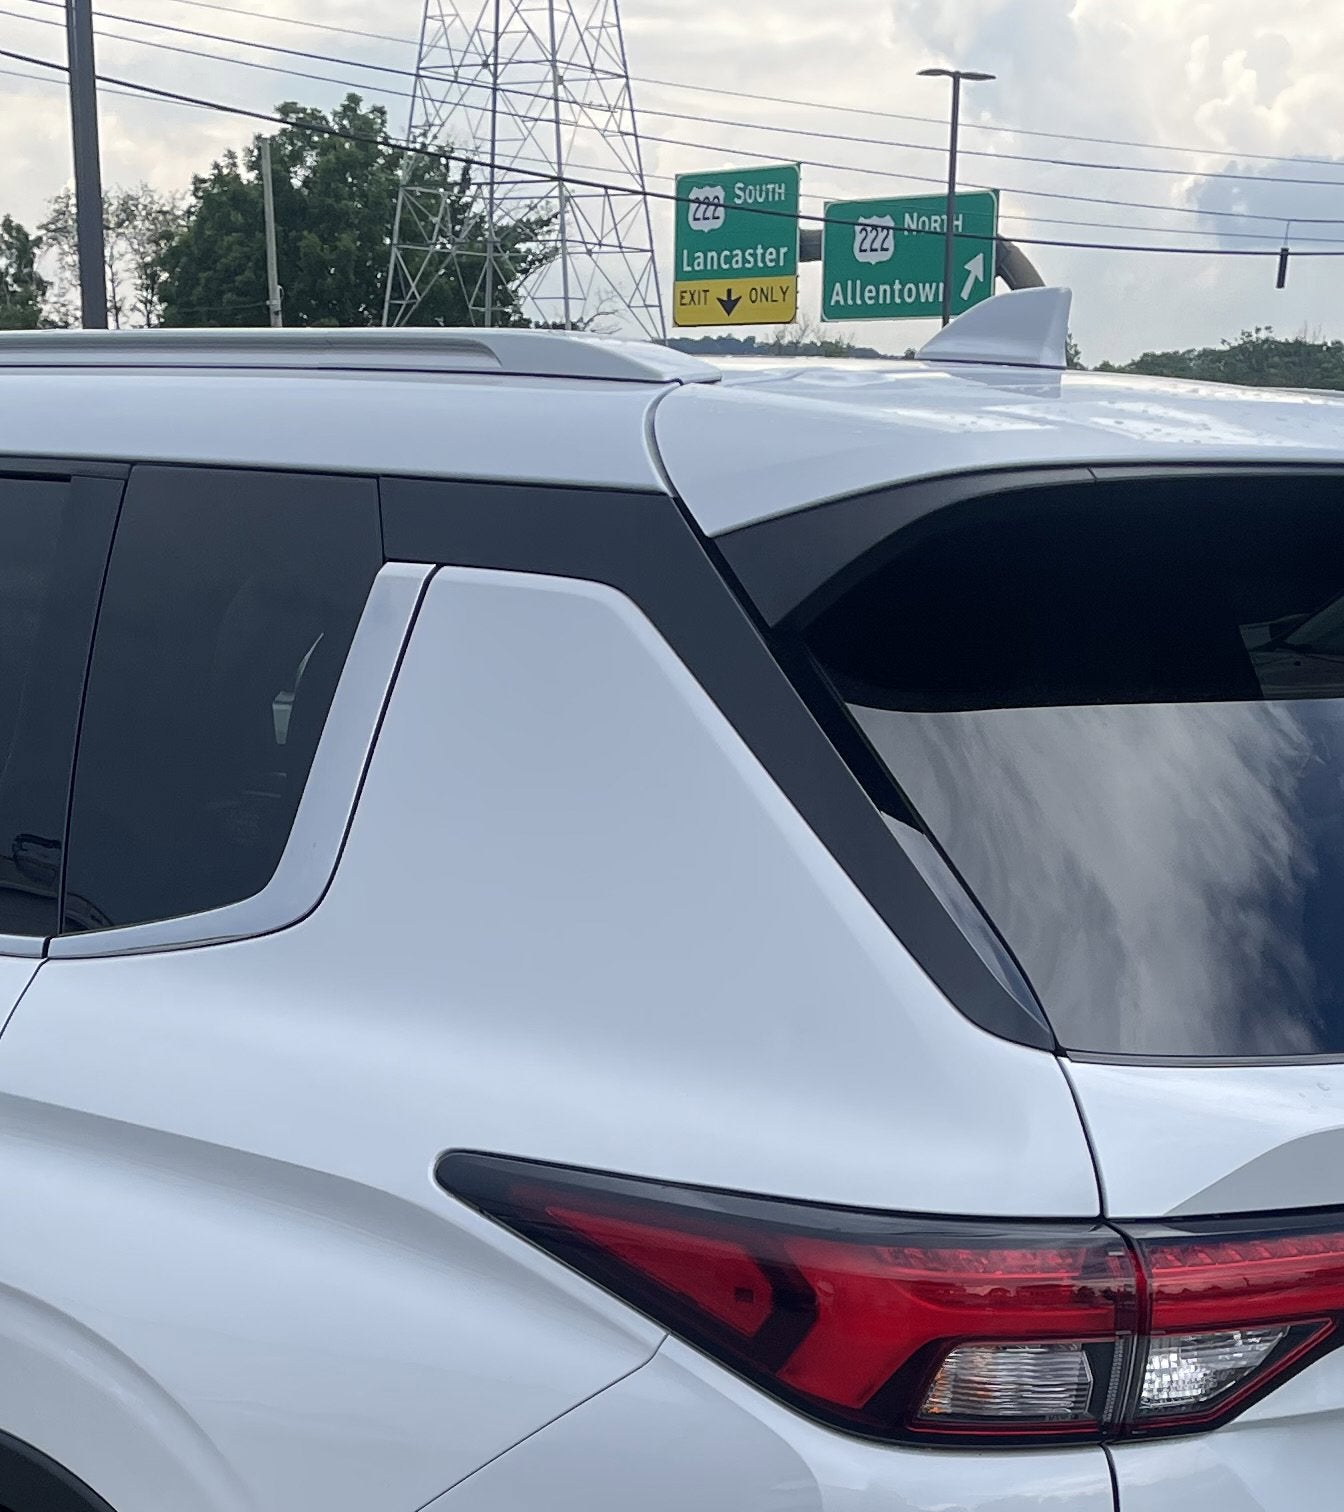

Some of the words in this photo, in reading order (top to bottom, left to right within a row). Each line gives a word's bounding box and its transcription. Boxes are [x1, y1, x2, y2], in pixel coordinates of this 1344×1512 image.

[692, 195, 721, 222] 222
[734, 182, 785, 204] SOUTH
[858, 226, 890, 253] 222
[903, 211, 963, 235] NORTH
[682, 244, 788, 272] Lancaster
[679, 289, 710, 306] EXIT
[749, 285, 790, 304] ONLY
